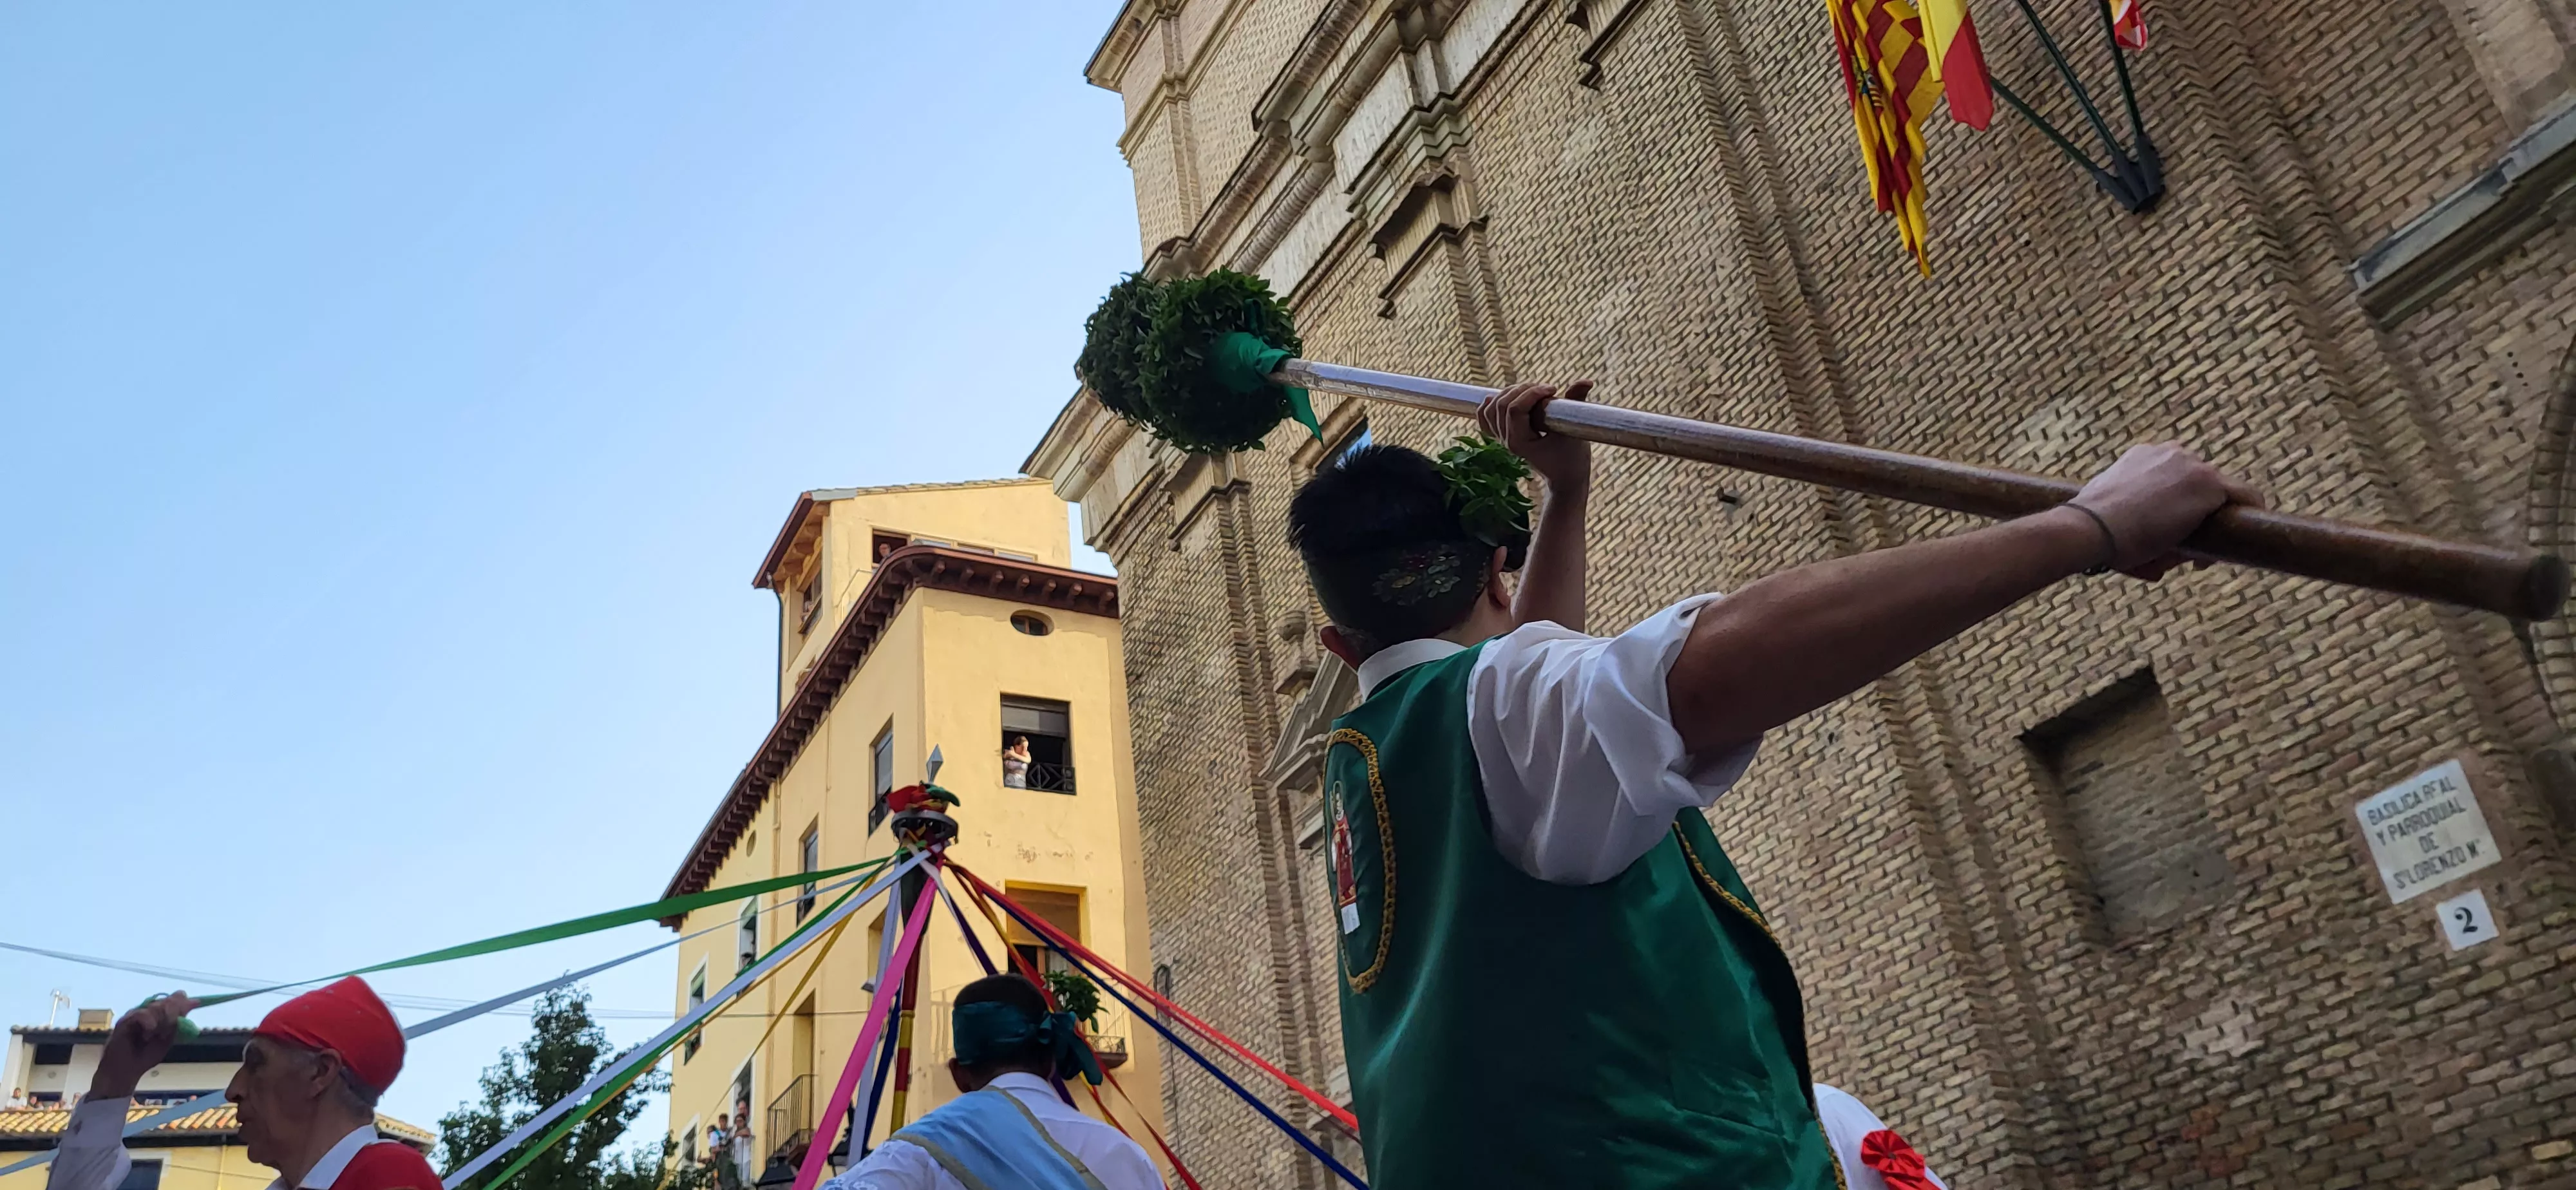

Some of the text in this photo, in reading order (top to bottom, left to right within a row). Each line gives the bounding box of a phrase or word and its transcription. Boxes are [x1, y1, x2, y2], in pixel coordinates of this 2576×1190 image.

[2376, 830, 2387, 846] Y
[2419, 831, 2439, 854] DE
[2454, 906, 2479, 934] 2
